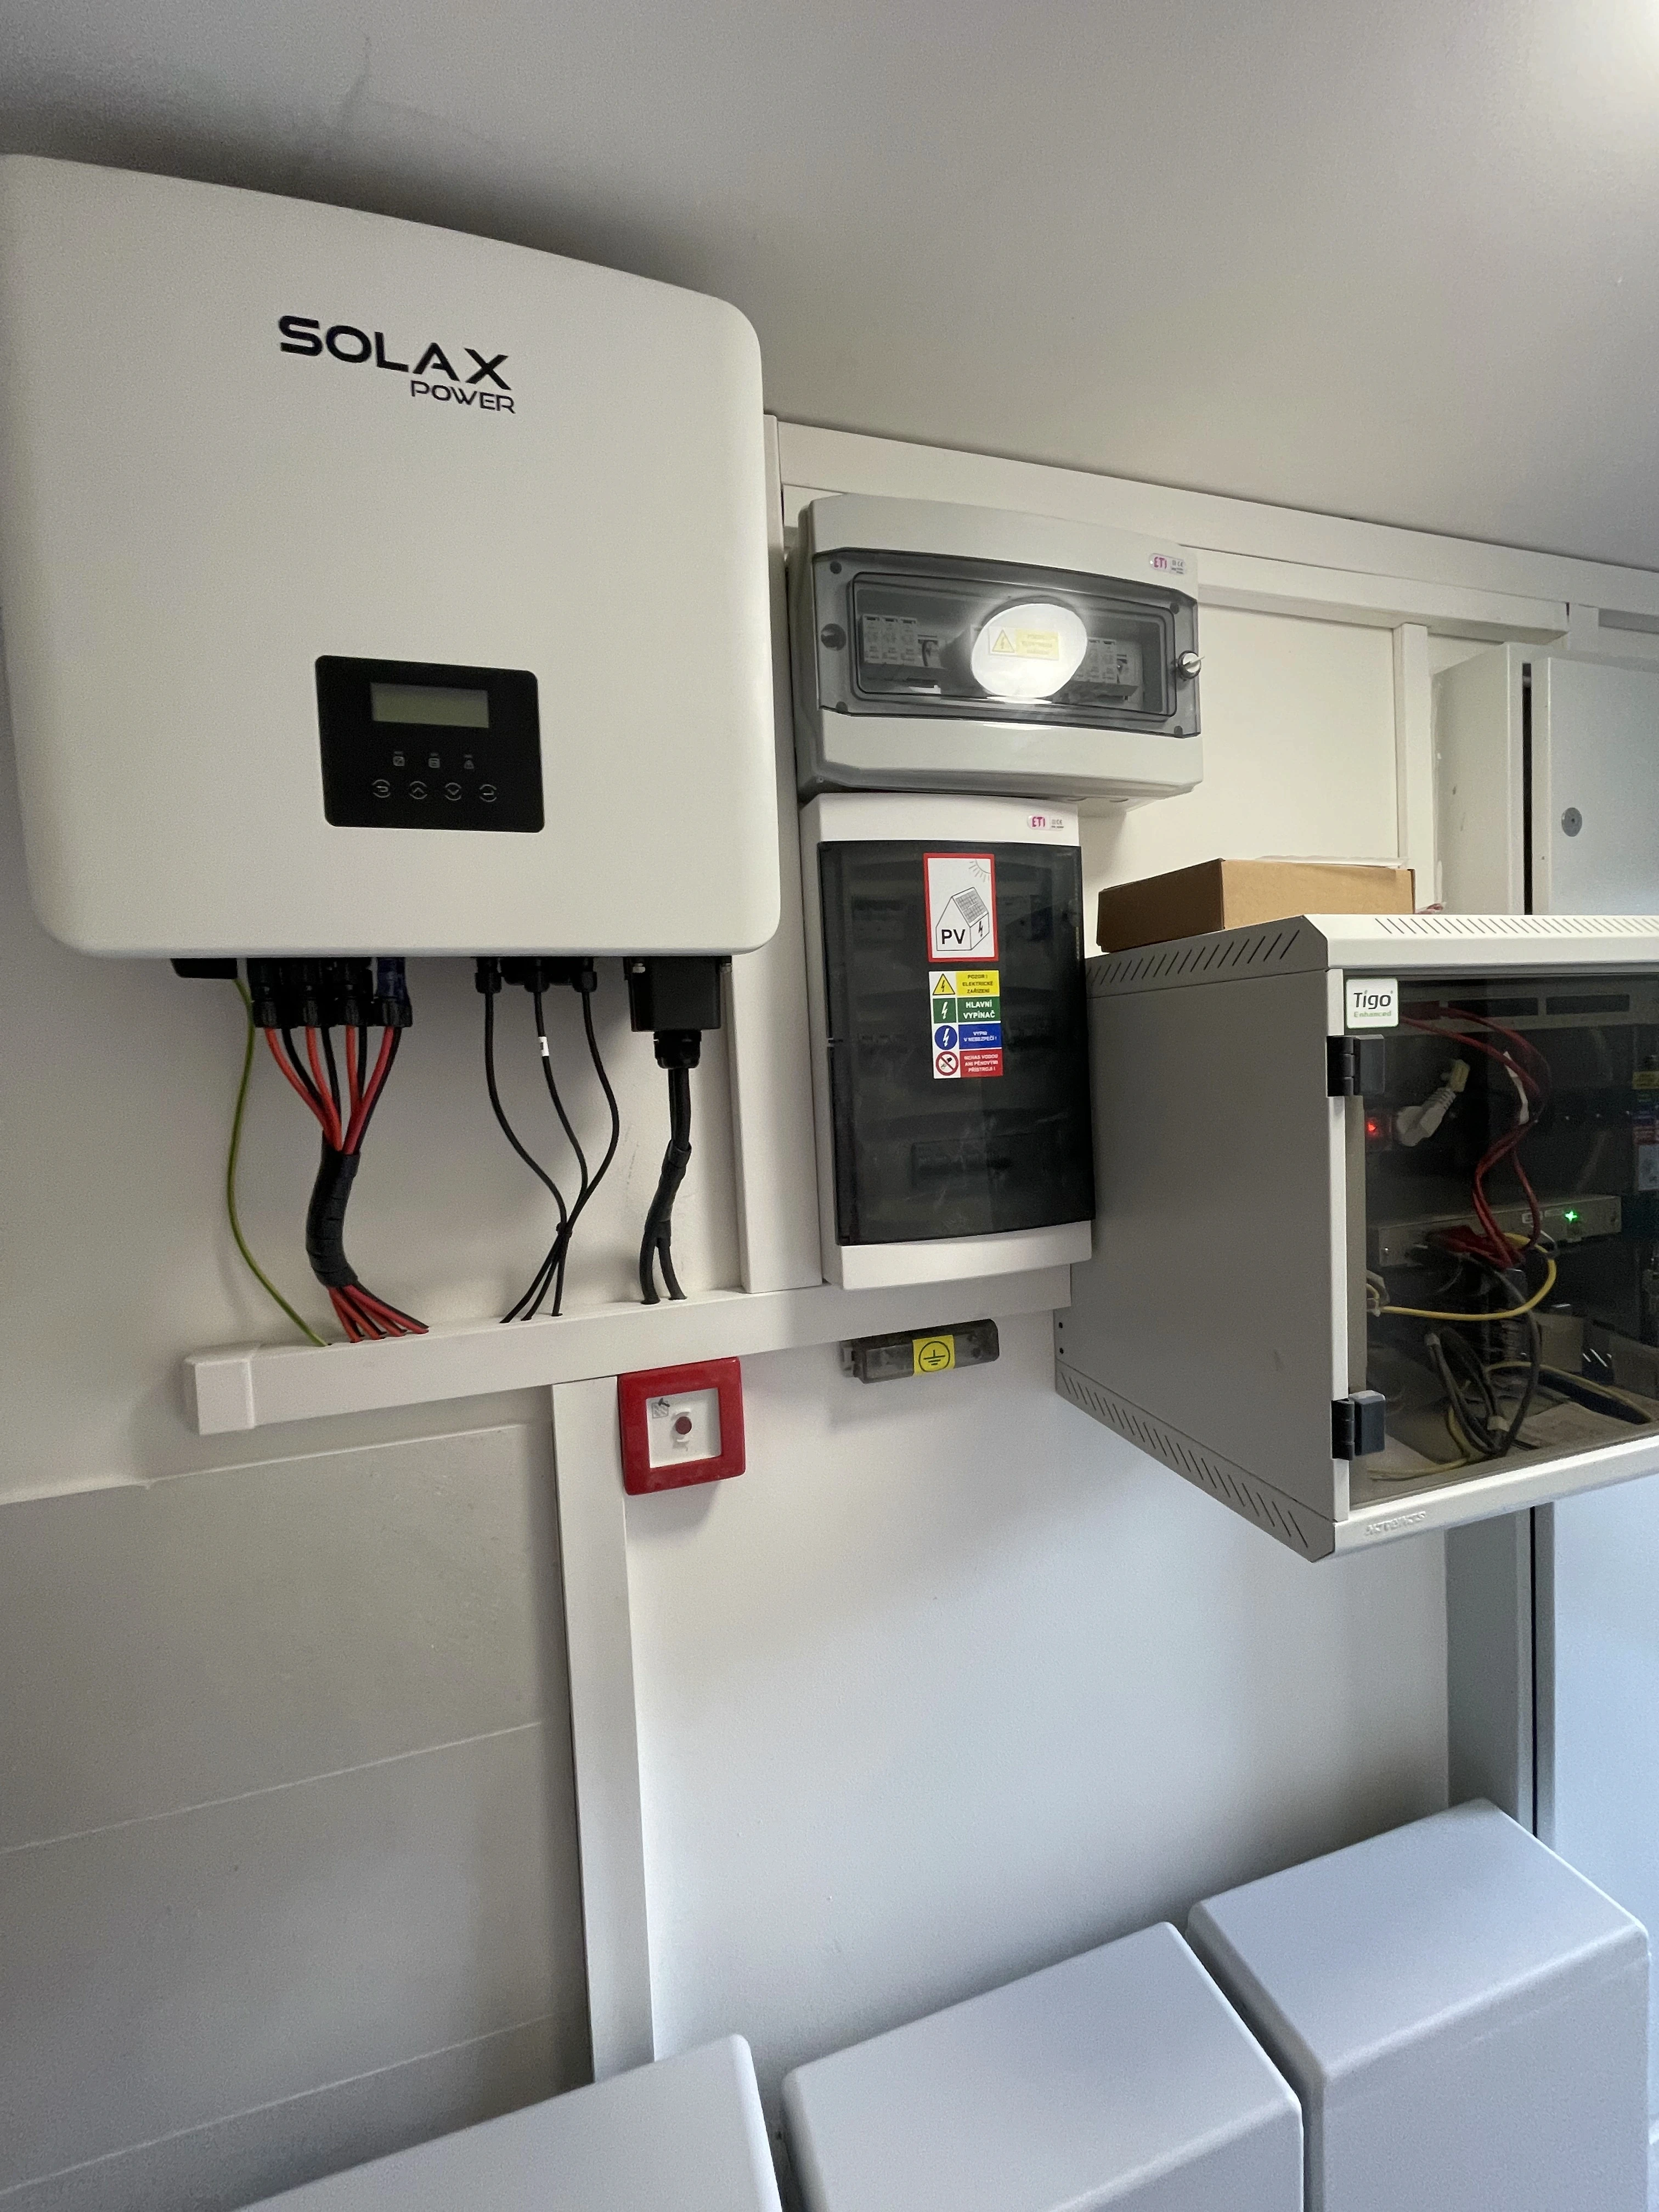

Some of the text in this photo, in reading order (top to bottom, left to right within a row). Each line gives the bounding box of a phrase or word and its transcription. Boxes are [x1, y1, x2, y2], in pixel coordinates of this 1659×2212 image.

[278, 315, 511, 390] SOLAX
[410, 380, 516, 414] POWER
[1154, 556, 1167, 569] ETI
[1032, 816, 1045, 827] ETI
[941, 929, 966, 945] PV
[966, 1000, 992, 1008] HLAVNÍ
[1353, 990, 1392, 1009] Tigo
[963, 1010, 996, 1019] VYPÍNAČ
